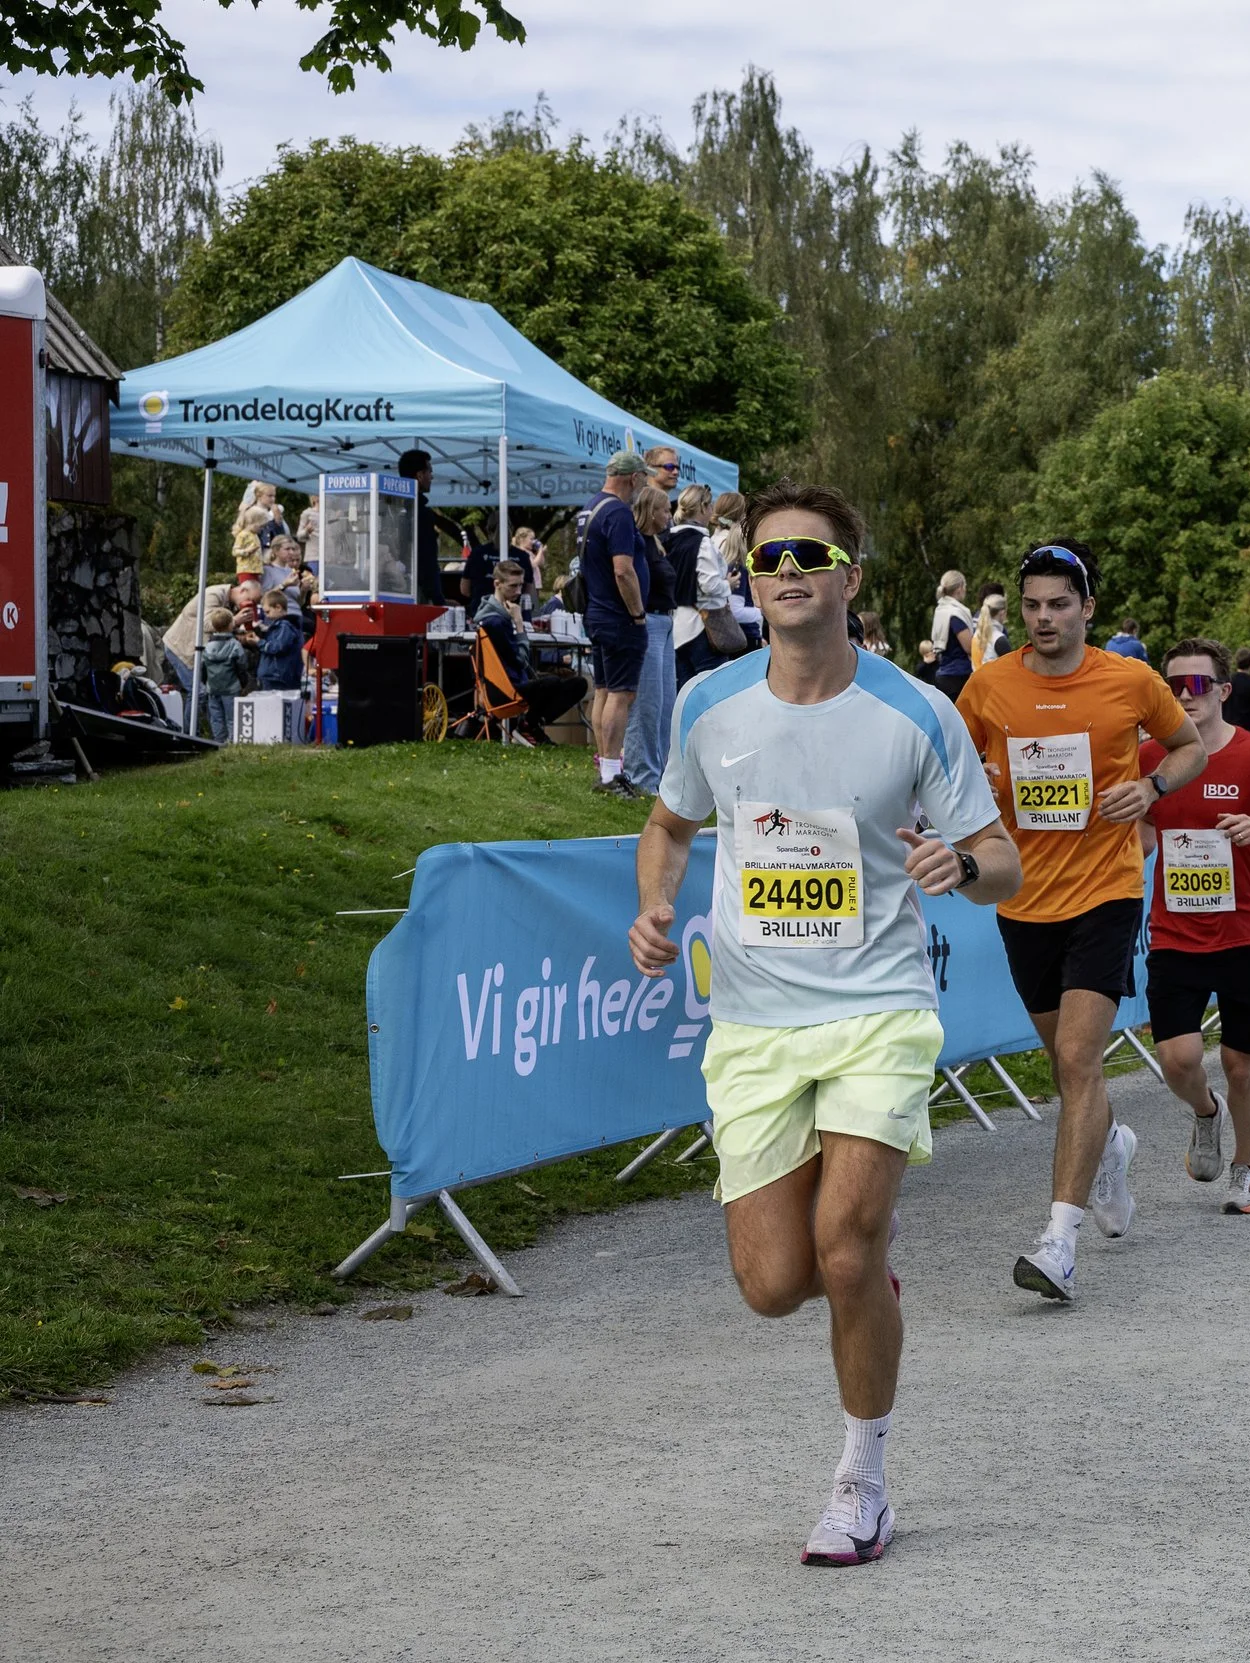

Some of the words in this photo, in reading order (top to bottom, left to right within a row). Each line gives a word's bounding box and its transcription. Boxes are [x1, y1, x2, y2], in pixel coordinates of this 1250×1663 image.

[179, 397, 396, 428] TrøndelagKraft
[574, 418, 585, 446] Vi
[587, 424, 599, 456] gir
[328, 476, 367, 488] POPCORN
[383, 477, 410, 493] POPCORN
[1020, 784, 1079, 806] 23221
[1207, 784, 1240, 796] BDO
[1029, 812, 1081, 823] BRILLIANT
[795, 821, 838, 834] TRONDHEIM
[795, 829, 833, 838] MARATON
[776, 845, 809, 853] SpareBank
[745, 861, 787, 870] BRILLIANT
[789, 861, 853, 870] HALVMARATON
[1170, 872, 1222, 891] 23069
[748, 877, 843, 911] 24490
[848, 876, 856, 904] PULJE
[1176, 896, 1222, 907] BRILLIANT
[760, 920, 842, 937] BRILLIANT
[457, 962, 504, 1061] Vi
[514, 957, 567, 1077] gir
[578, 956, 674, 1042] hele
